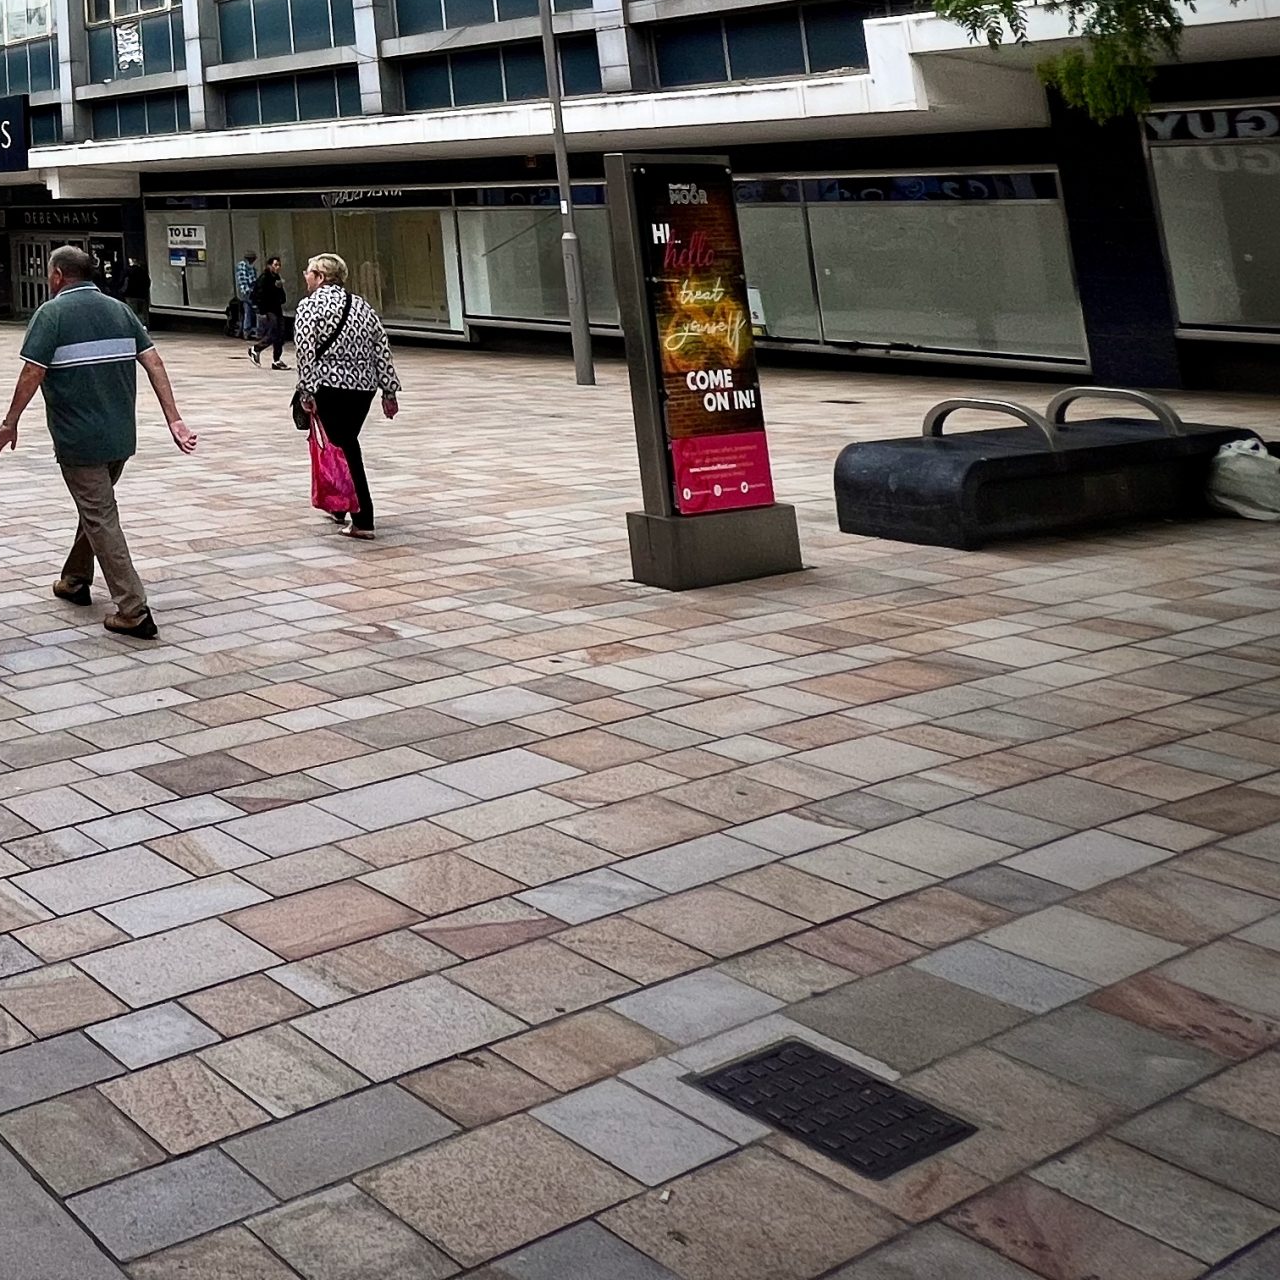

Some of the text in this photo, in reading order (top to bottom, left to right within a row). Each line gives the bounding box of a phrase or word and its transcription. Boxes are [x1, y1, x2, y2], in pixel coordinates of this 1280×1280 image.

[23, 211, 99, 225] DEBENHAMS
[168, 227, 197, 237] TO LET
[663, 228, 716, 270] hello
[679, 276, 725, 305] treat
[665, 310, 747, 357] yourself
[686, 368, 734, 391] COME
[703, 389, 756, 412] ON IN!
